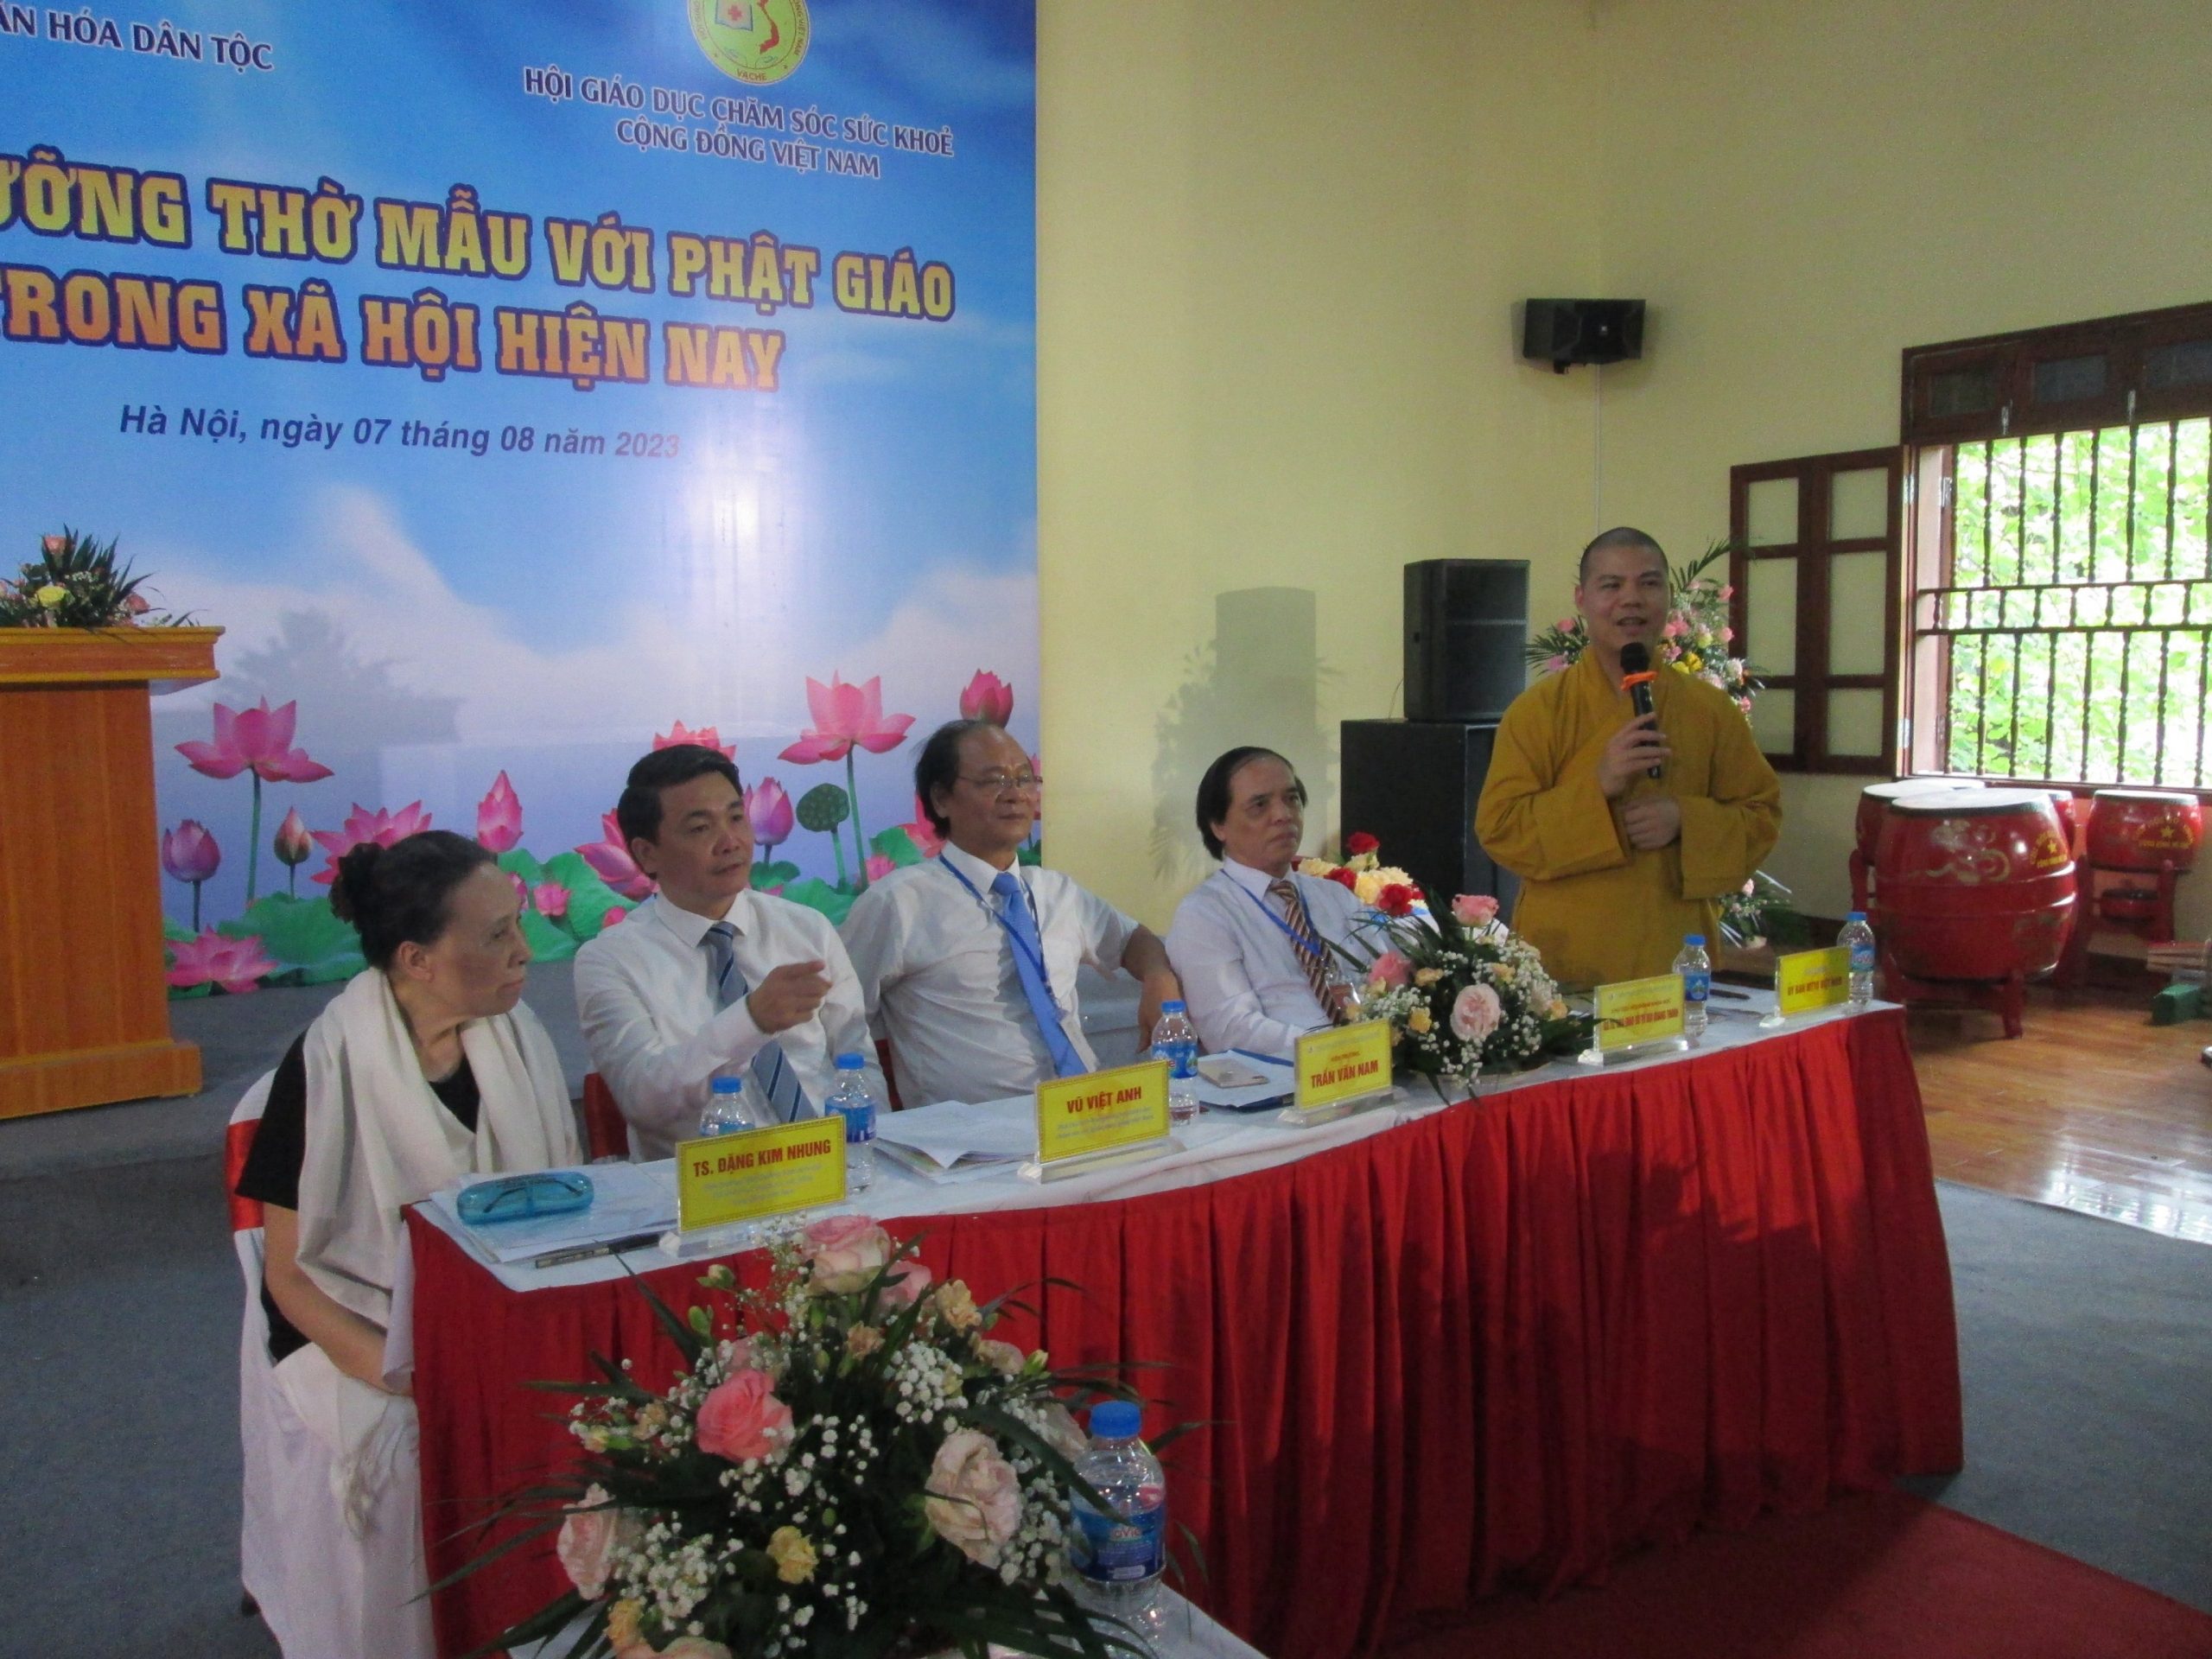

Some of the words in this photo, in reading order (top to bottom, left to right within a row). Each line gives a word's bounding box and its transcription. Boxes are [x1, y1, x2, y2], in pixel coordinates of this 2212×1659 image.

[48, 9, 121, 48] HÓA
[133, 20, 201, 60] DÂN
[212, 34, 273, 73] TỘC
[736, 69, 767, 80] VACHE
[524, 66, 572, 105] HỘI
[581, 75, 645, 108] GIÁO
[653, 88, 704, 121] DỤC
[711, 96, 784, 130] CHĂM
[792, 106, 836, 137] SÓC
[844, 109, 887, 146] SỨC
[617, 116, 688, 151] CỘNG
[696, 124, 766, 162] ĐỒNG
[772, 139, 819, 173] VIỆT
[827, 149, 880, 178] NAM
[207, 176, 364, 262] THỜ
[373, 183, 532, 281] MẪU
[544, 210, 654, 294] VỚI
[667, 229, 820, 316] PHẬT
[833, 246, 955, 322] GIÁO
[0, 263, 227, 355] RONG
[243, 277, 347, 363] XÃ
[359, 286, 482, 382] HỘI
[494, 300, 651, 391] HIỆN
[663, 321, 785, 392] NAY
[119, 404, 168, 435] Hà
[180, 407, 247, 444] Nội,
[260, 414, 344, 448] ngày
[353, 417, 391, 445] 07
[401, 420, 490, 456] tháng
[500, 425, 534, 453] 08
[544, 427, 605, 455] năm
[614, 431, 679, 459] 2023
[1087, 1091, 1113, 1109] VIỆT
[1116, 1086, 1141, 1104] ANH
[1337, 1065, 1356, 1082] VĂN
[1358, 1060, 1378, 1077] NAM
[693, 1161, 714, 1177] TS.
[718, 1152, 754, 1175] ĐẶNG
[758, 1147, 784, 1166] KIM
[787, 1139, 831, 1160] NHUNG
